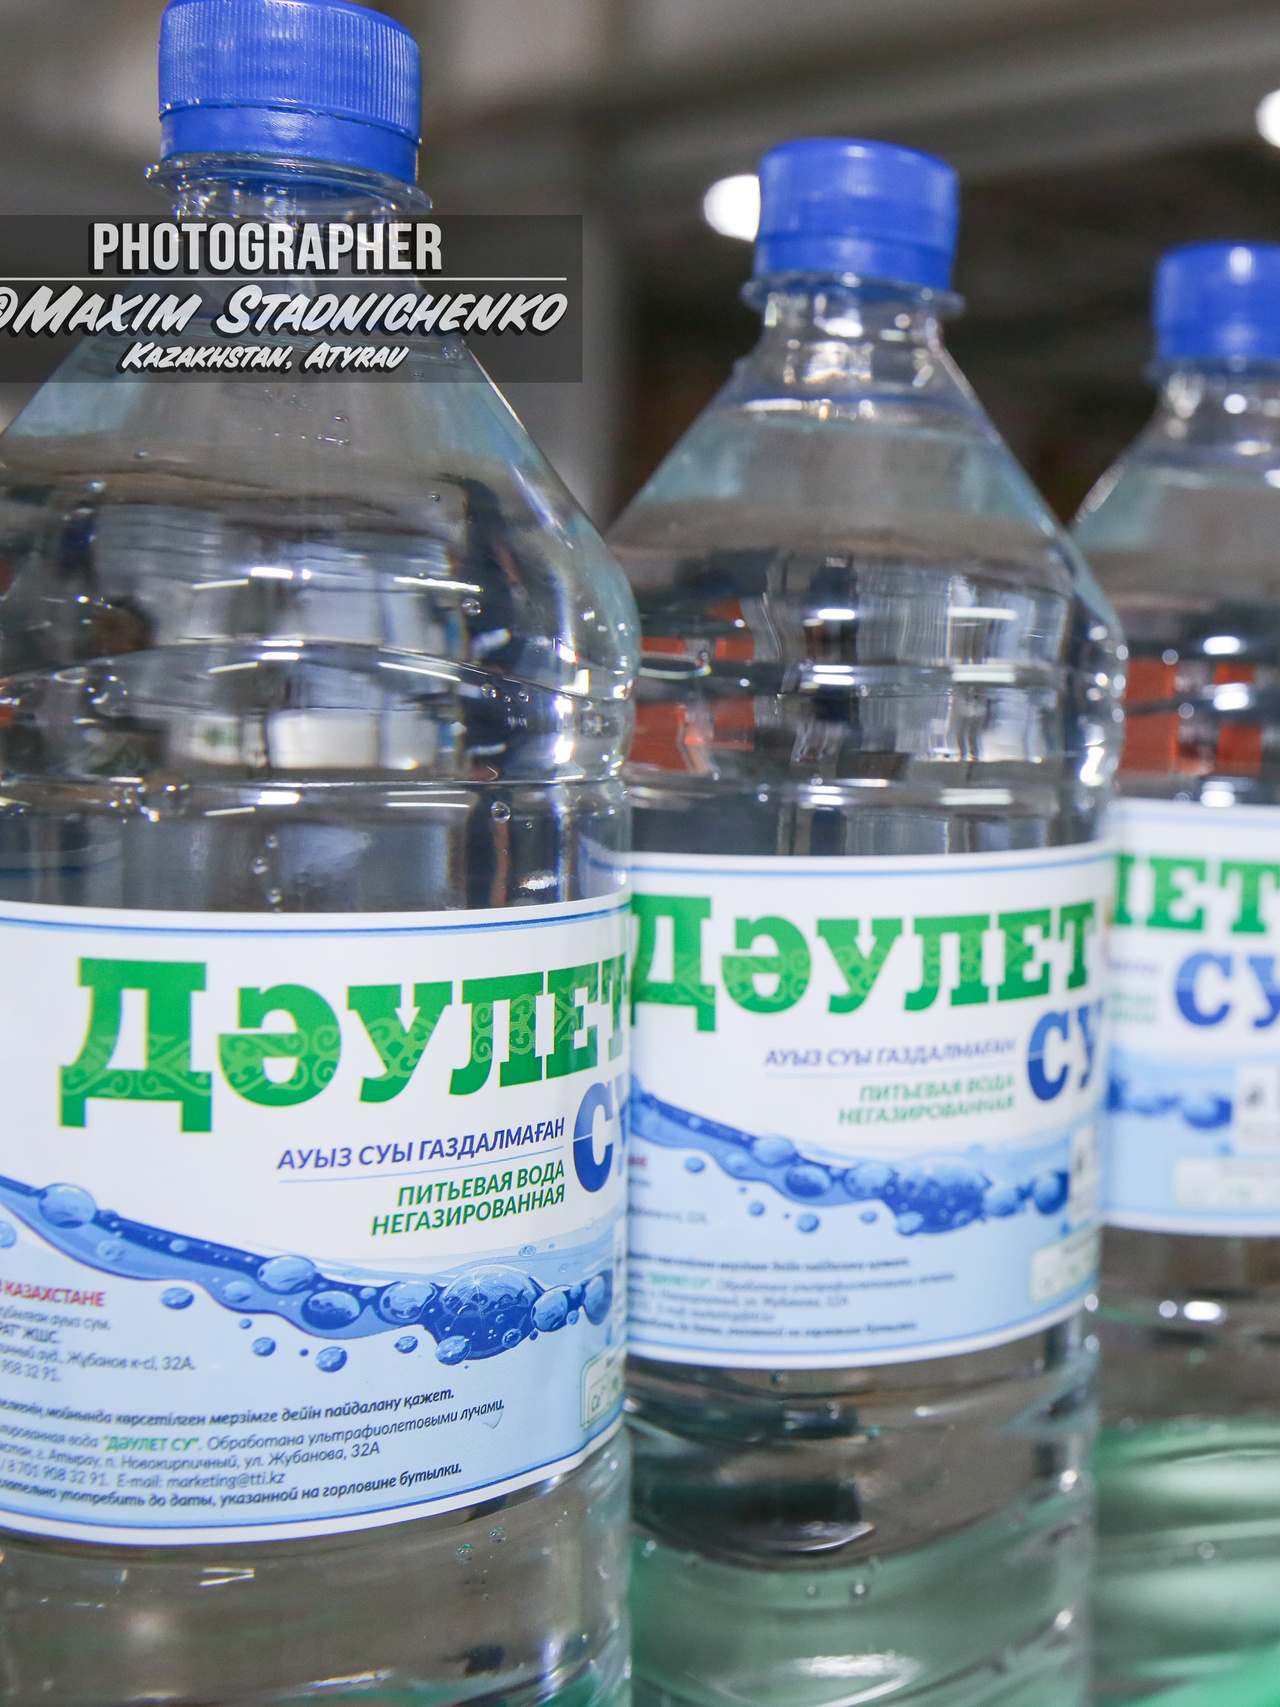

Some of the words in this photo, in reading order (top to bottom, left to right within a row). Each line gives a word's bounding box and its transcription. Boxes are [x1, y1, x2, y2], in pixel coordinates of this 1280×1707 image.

[277, 1147, 352, 1170] АУЫЗ
[358, 1142, 412, 1165] СУЫ
[418, 1117, 565, 1160] ГАЗДАЛМАҒАН
[397, 1171, 513, 1207] ПИТЬЕВАЯ
[516, 1159, 565, 1189] ВОДА
[371, 1183, 565, 1236] НЕГАЗИРОВАННАЯ
[5, 1281, 105, 1307] КАЗАХСТАНЕ
[207, 1433, 304, 1452] Обработана
[308, 1411, 458, 1445] ультрафиолетовыми
[459, 1400, 505, 1421] лучами.
[209, 1410, 278, 1427] мерзімге
[281, 1405, 321, 1421] дейін
[324, 1398, 402, 1418] пайдалану
[404, 1388, 454, 1409] қажет.
[42, 1465, 66, 1482] 908
[69, 1469, 86, 1485] 32
[117, 1474, 162, 1488] E-mail:
[167, 1471, 286, 1490] marketing@tti.kz
[120, 1455, 239, 1472] Новокирпичный,
[244, 1457, 264, 1470] ул.
[267, 1449, 347, 1467] Жубанова,
[351, 1441, 380, 1458] 32А
[59, 1490, 145, 1506] употребить
[148, 1493, 167, 1507] до
[169, 1493, 216, 1507] даты,
[220, 1486, 298, 1508] указанной
[301, 1487, 319, 1500] на
[322, 1476, 397, 1498] горловине
[400, 1463, 462, 1487] бутылки.
